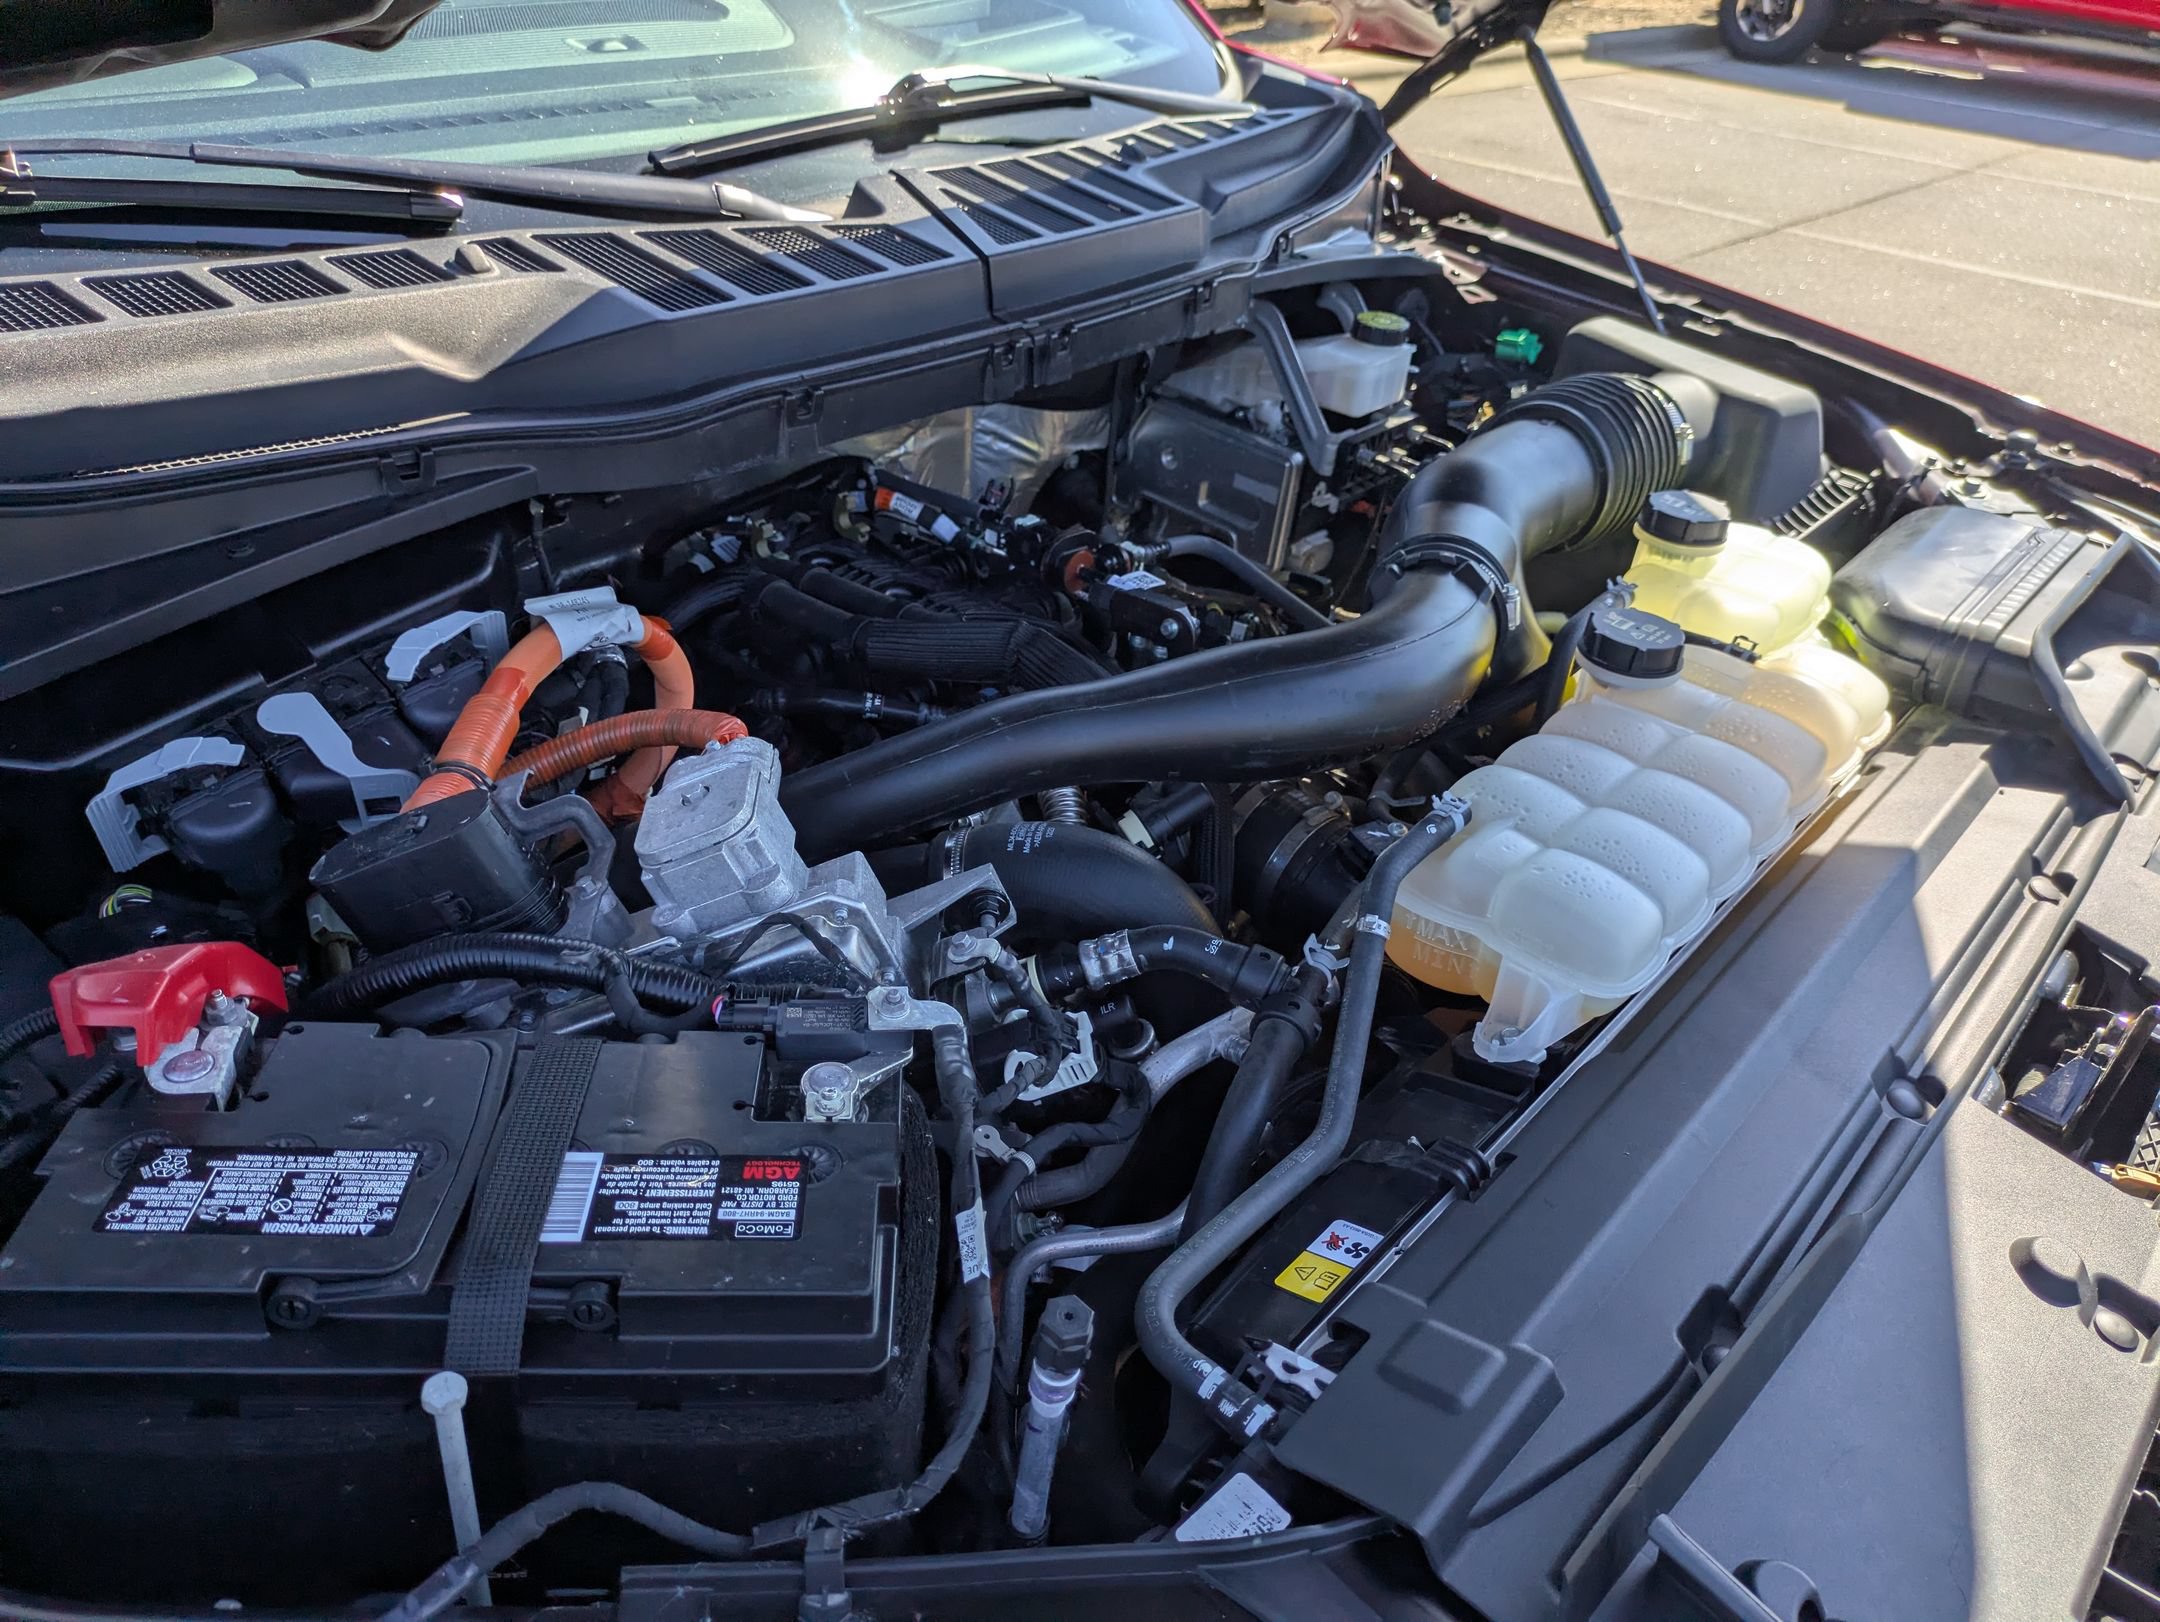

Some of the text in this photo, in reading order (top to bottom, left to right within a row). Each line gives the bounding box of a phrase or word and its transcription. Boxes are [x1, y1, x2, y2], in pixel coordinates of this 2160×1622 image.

[1415, 921, 1469, 951] MAX
[1413, 942, 1464, 975] MIN
[742, 1166, 800, 1180] AGM
[619, 1180, 638, 1188] guide
[331, 1186, 344, 1194] LES
[756, 1186, 798, 1194] DEARBORN,
[245, 1206, 264, 1214] ACID
[662, 1202, 694, 1210] cranking
[226, 1212, 260, 1220] SULFURIC
[332, 1208, 368, 1216] EXPLOSIVE
[688, 1217, 710, 1225] injury
[105, 1222, 146, 1230] IMMEDIATELY
[262, 1222, 358, 1234] DANGER/POISON
[594, 1225, 628, 1234] personal
[629, 1226, 650, 1234] avoid
[738, 1224, 791, 1234] FoMoCo
[663, 1226, 708, 1235] WARNING:
